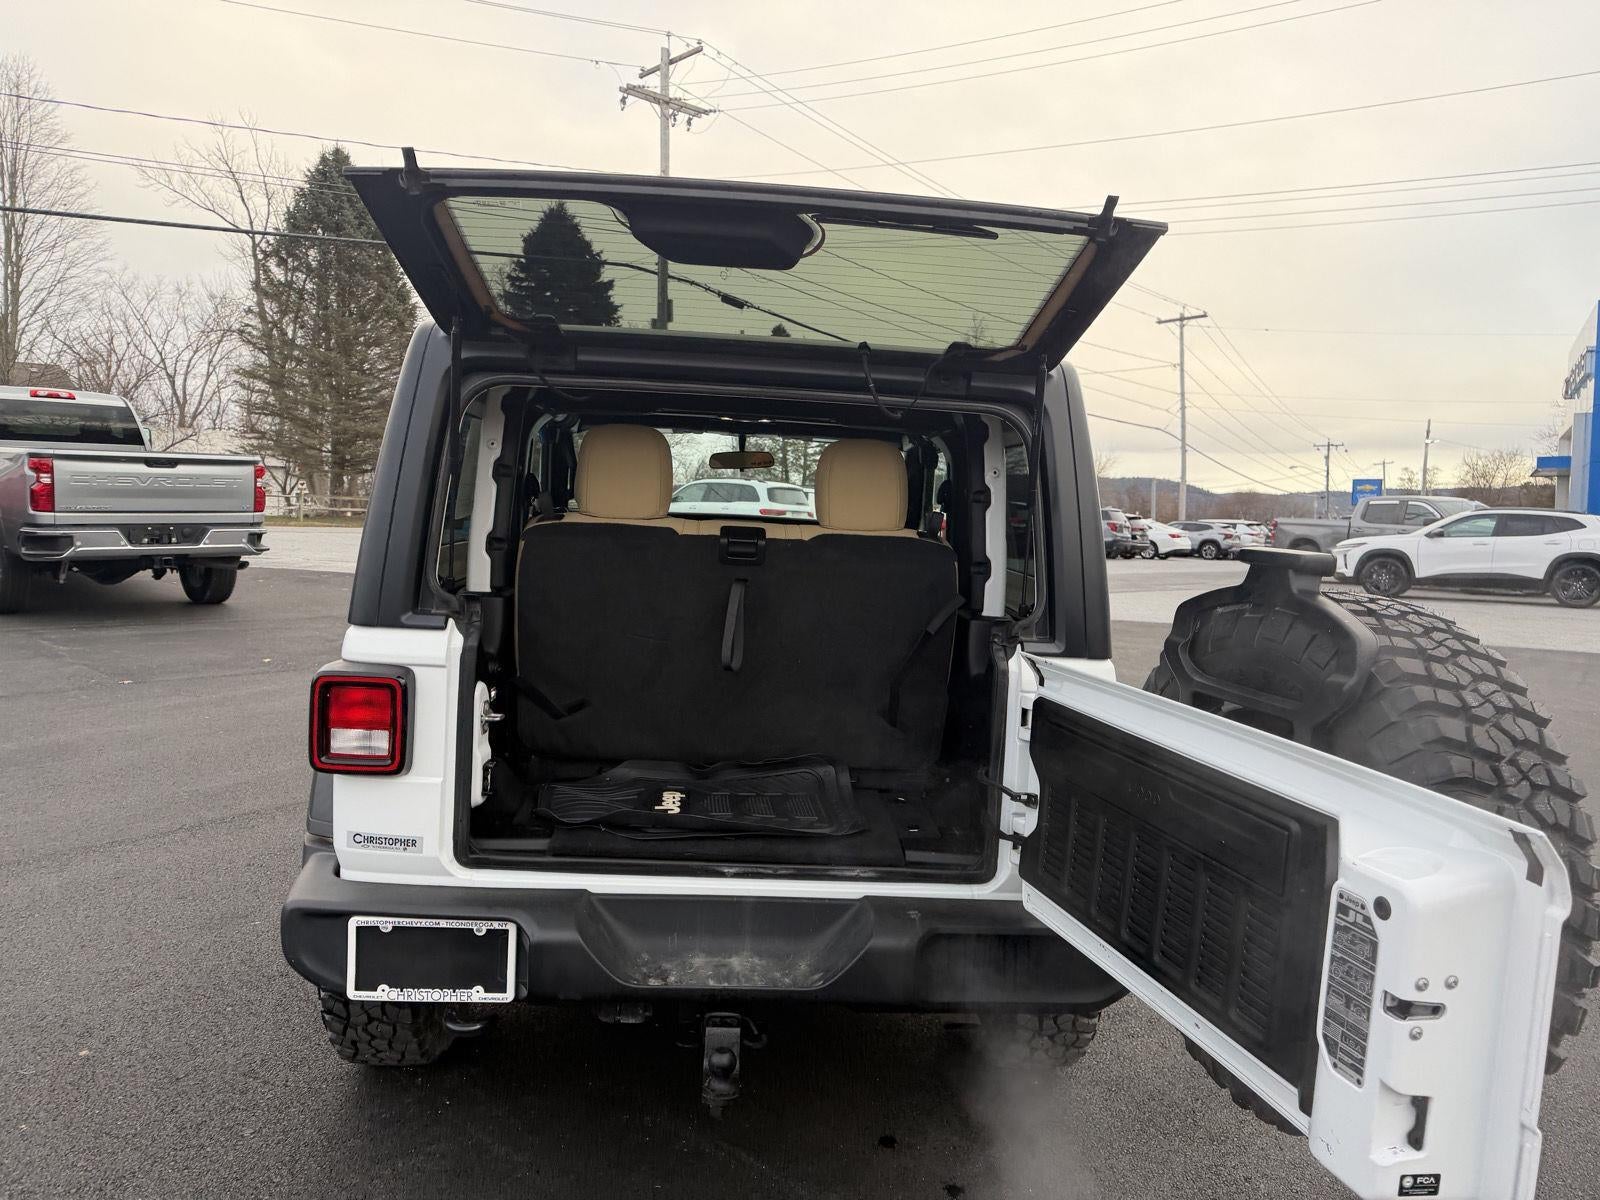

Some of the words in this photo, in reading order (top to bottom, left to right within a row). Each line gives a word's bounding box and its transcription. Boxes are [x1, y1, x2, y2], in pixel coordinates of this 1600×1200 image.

[70, 474, 243, 488] CHEVROLET
[654, 791, 686, 814] Jeep
[352, 833, 418, 848] CHRISTOPHER
[355, 919, 441, 927] CHRISTOPHERCHEVY.COM
[386, 989, 473, 1002] CHRISTOPHER
[1416, 1176, 1436, 1185] FCA
